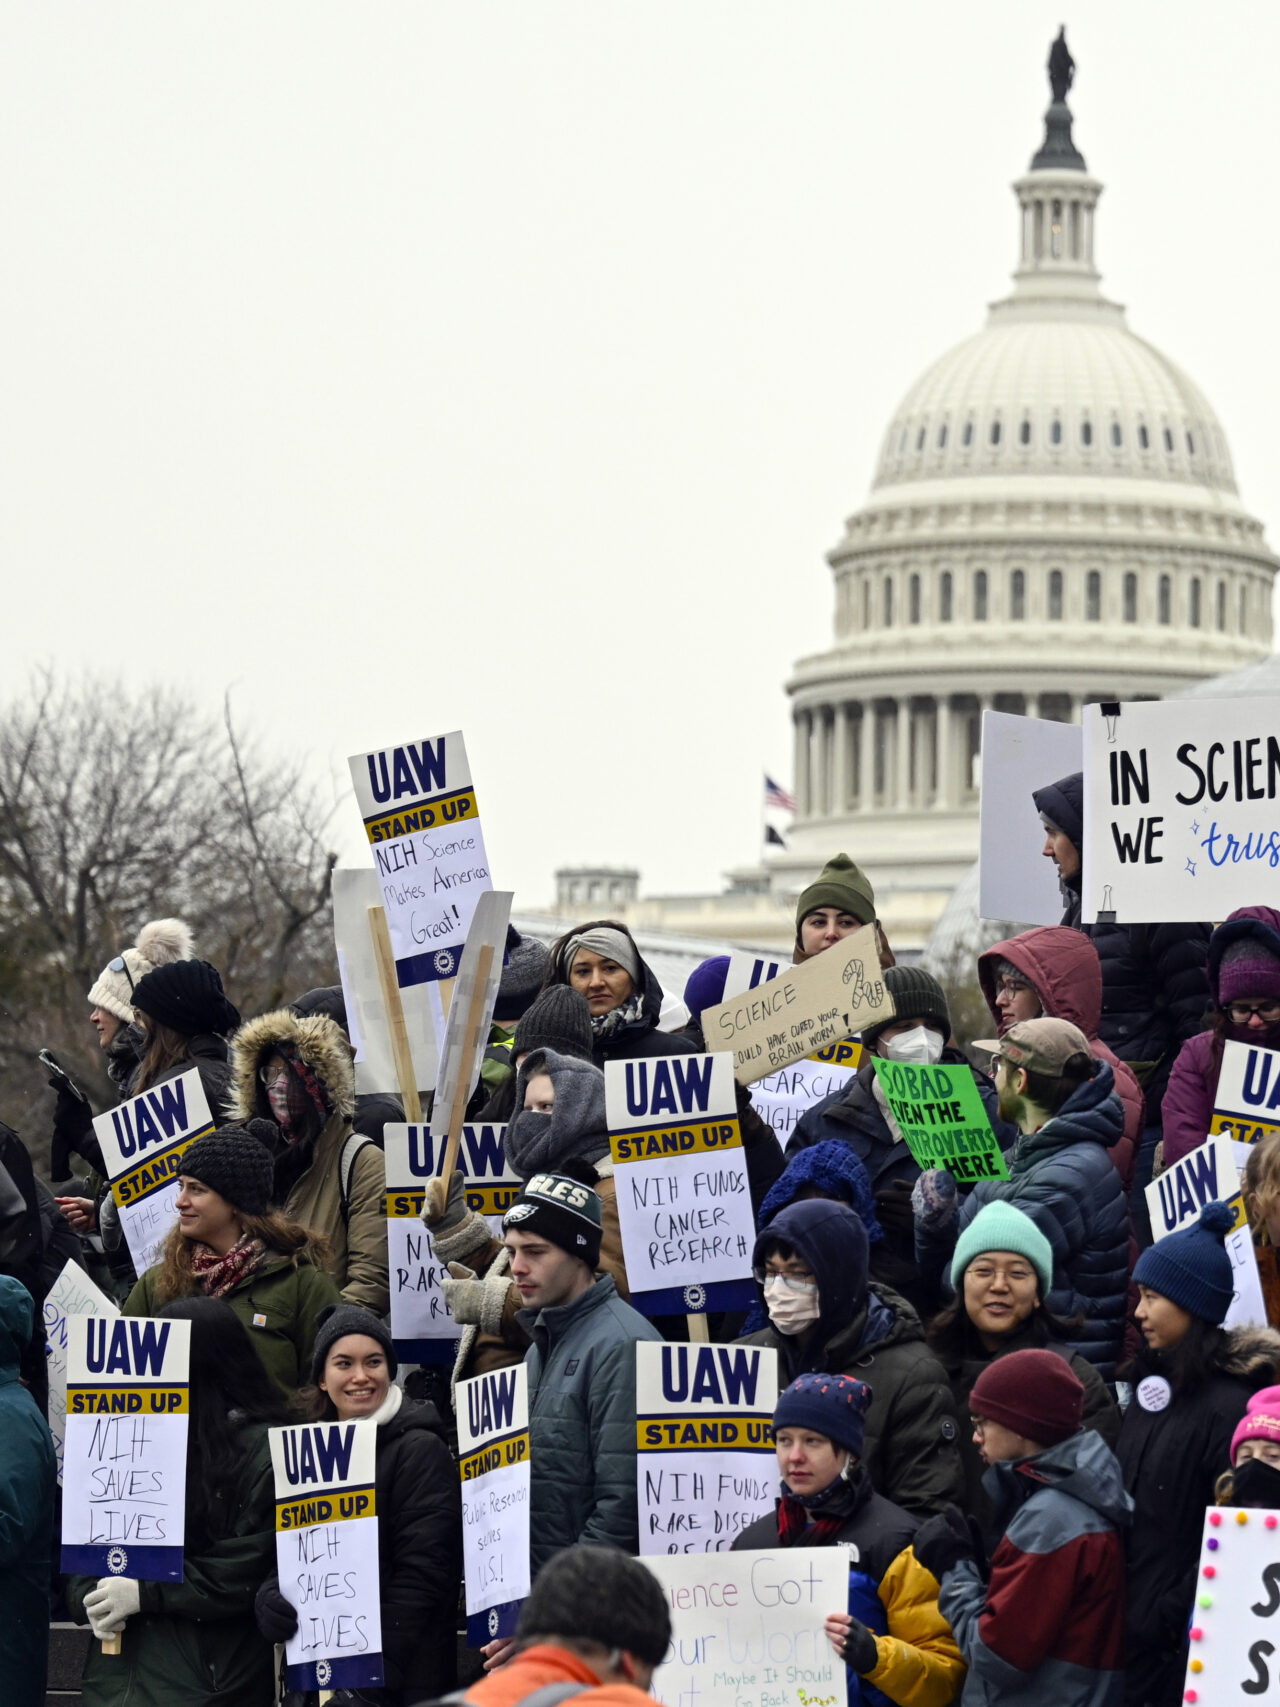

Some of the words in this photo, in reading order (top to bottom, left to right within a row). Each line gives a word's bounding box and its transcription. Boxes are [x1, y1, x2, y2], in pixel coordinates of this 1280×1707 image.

[366, 736, 447, 805] UAW
[1109, 747, 1150, 806] IN
[371, 808, 436, 843] STAND
[442, 797, 471, 821] UP
[1110, 816, 1164, 865] WE
[375, 839, 418, 878] NIH
[422, 833, 476, 861] Science
[383, 883, 426, 911] Makes
[432, 866, 489, 894] America
[719, 983, 797, 1040] SCIENCE
[766, 1031, 787, 1052] HAVE
[790, 1017, 815, 1038] CURED
[817, 1007, 841, 1026] YOUR
[768, 1041, 805, 1067] BRAIN
[808, 1023, 836, 1047] WORM
[816, 1045, 854, 1063] UP
[624, 1056, 714, 1118] UAW
[111, 1077, 190, 1159] UAW
[617, 1130, 695, 1159] STAND
[701, 1124, 734, 1148] UP
[942, 1152, 1001, 1179] HERE
[394, 1193, 485, 1216] STD
[631, 1176, 679, 1211] NIH
[693, 1169, 746, 1198] FUNDS
[1157, 1142, 1219, 1232] UAW
[126, 1203, 161, 1240] THE
[654, 1206, 731, 1241] CANCER
[406, 1233, 433, 1266] NI
[648, 1234, 748, 1270] RESEARCH
[86, 1317, 172, 1377] UAW
[661, 1345, 761, 1406] UAW
[72, 1392, 143, 1414] STAND
[150, 1392, 183, 1413] UP
[467, 1368, 517, 1438] UAW
[88, 1415, 152, 1463] NIH
[645, 1422, 739, 1445] STAND
[747, 1423, 777, 1443] UP
[281, 1424, 357, 1486] UAW
[464, 1449, 501, 1481] STAND
[505, 1439, 527, 1465] UP
[90, 1466, 163, 1500] SAVES
[489, 1486, 527, 1513] Research
[645, 1469, 704, 1506] NIH
[717, 1474, 769, 1502] FUNDS
[88, 1507, 167, 1545] LIVES
[281, 1499, 333, 1528] STAND
[339, 1494, 369, 1518] UP
[649, 1512, 702, 1535] RARE
[298, 1526, 341, 1566] NIH
[297, 1571, 357, 1605] SAVES
[670, 1582, 739, 1611] ience
[751, 1556, 824, 1609] Got
[298, 1614, 369, 1652] LIVES
[713, 1671, 757, 1694] Maybe
[763, 1667, 778, 1684] It
[786, 1665, 833, 1686] Should
